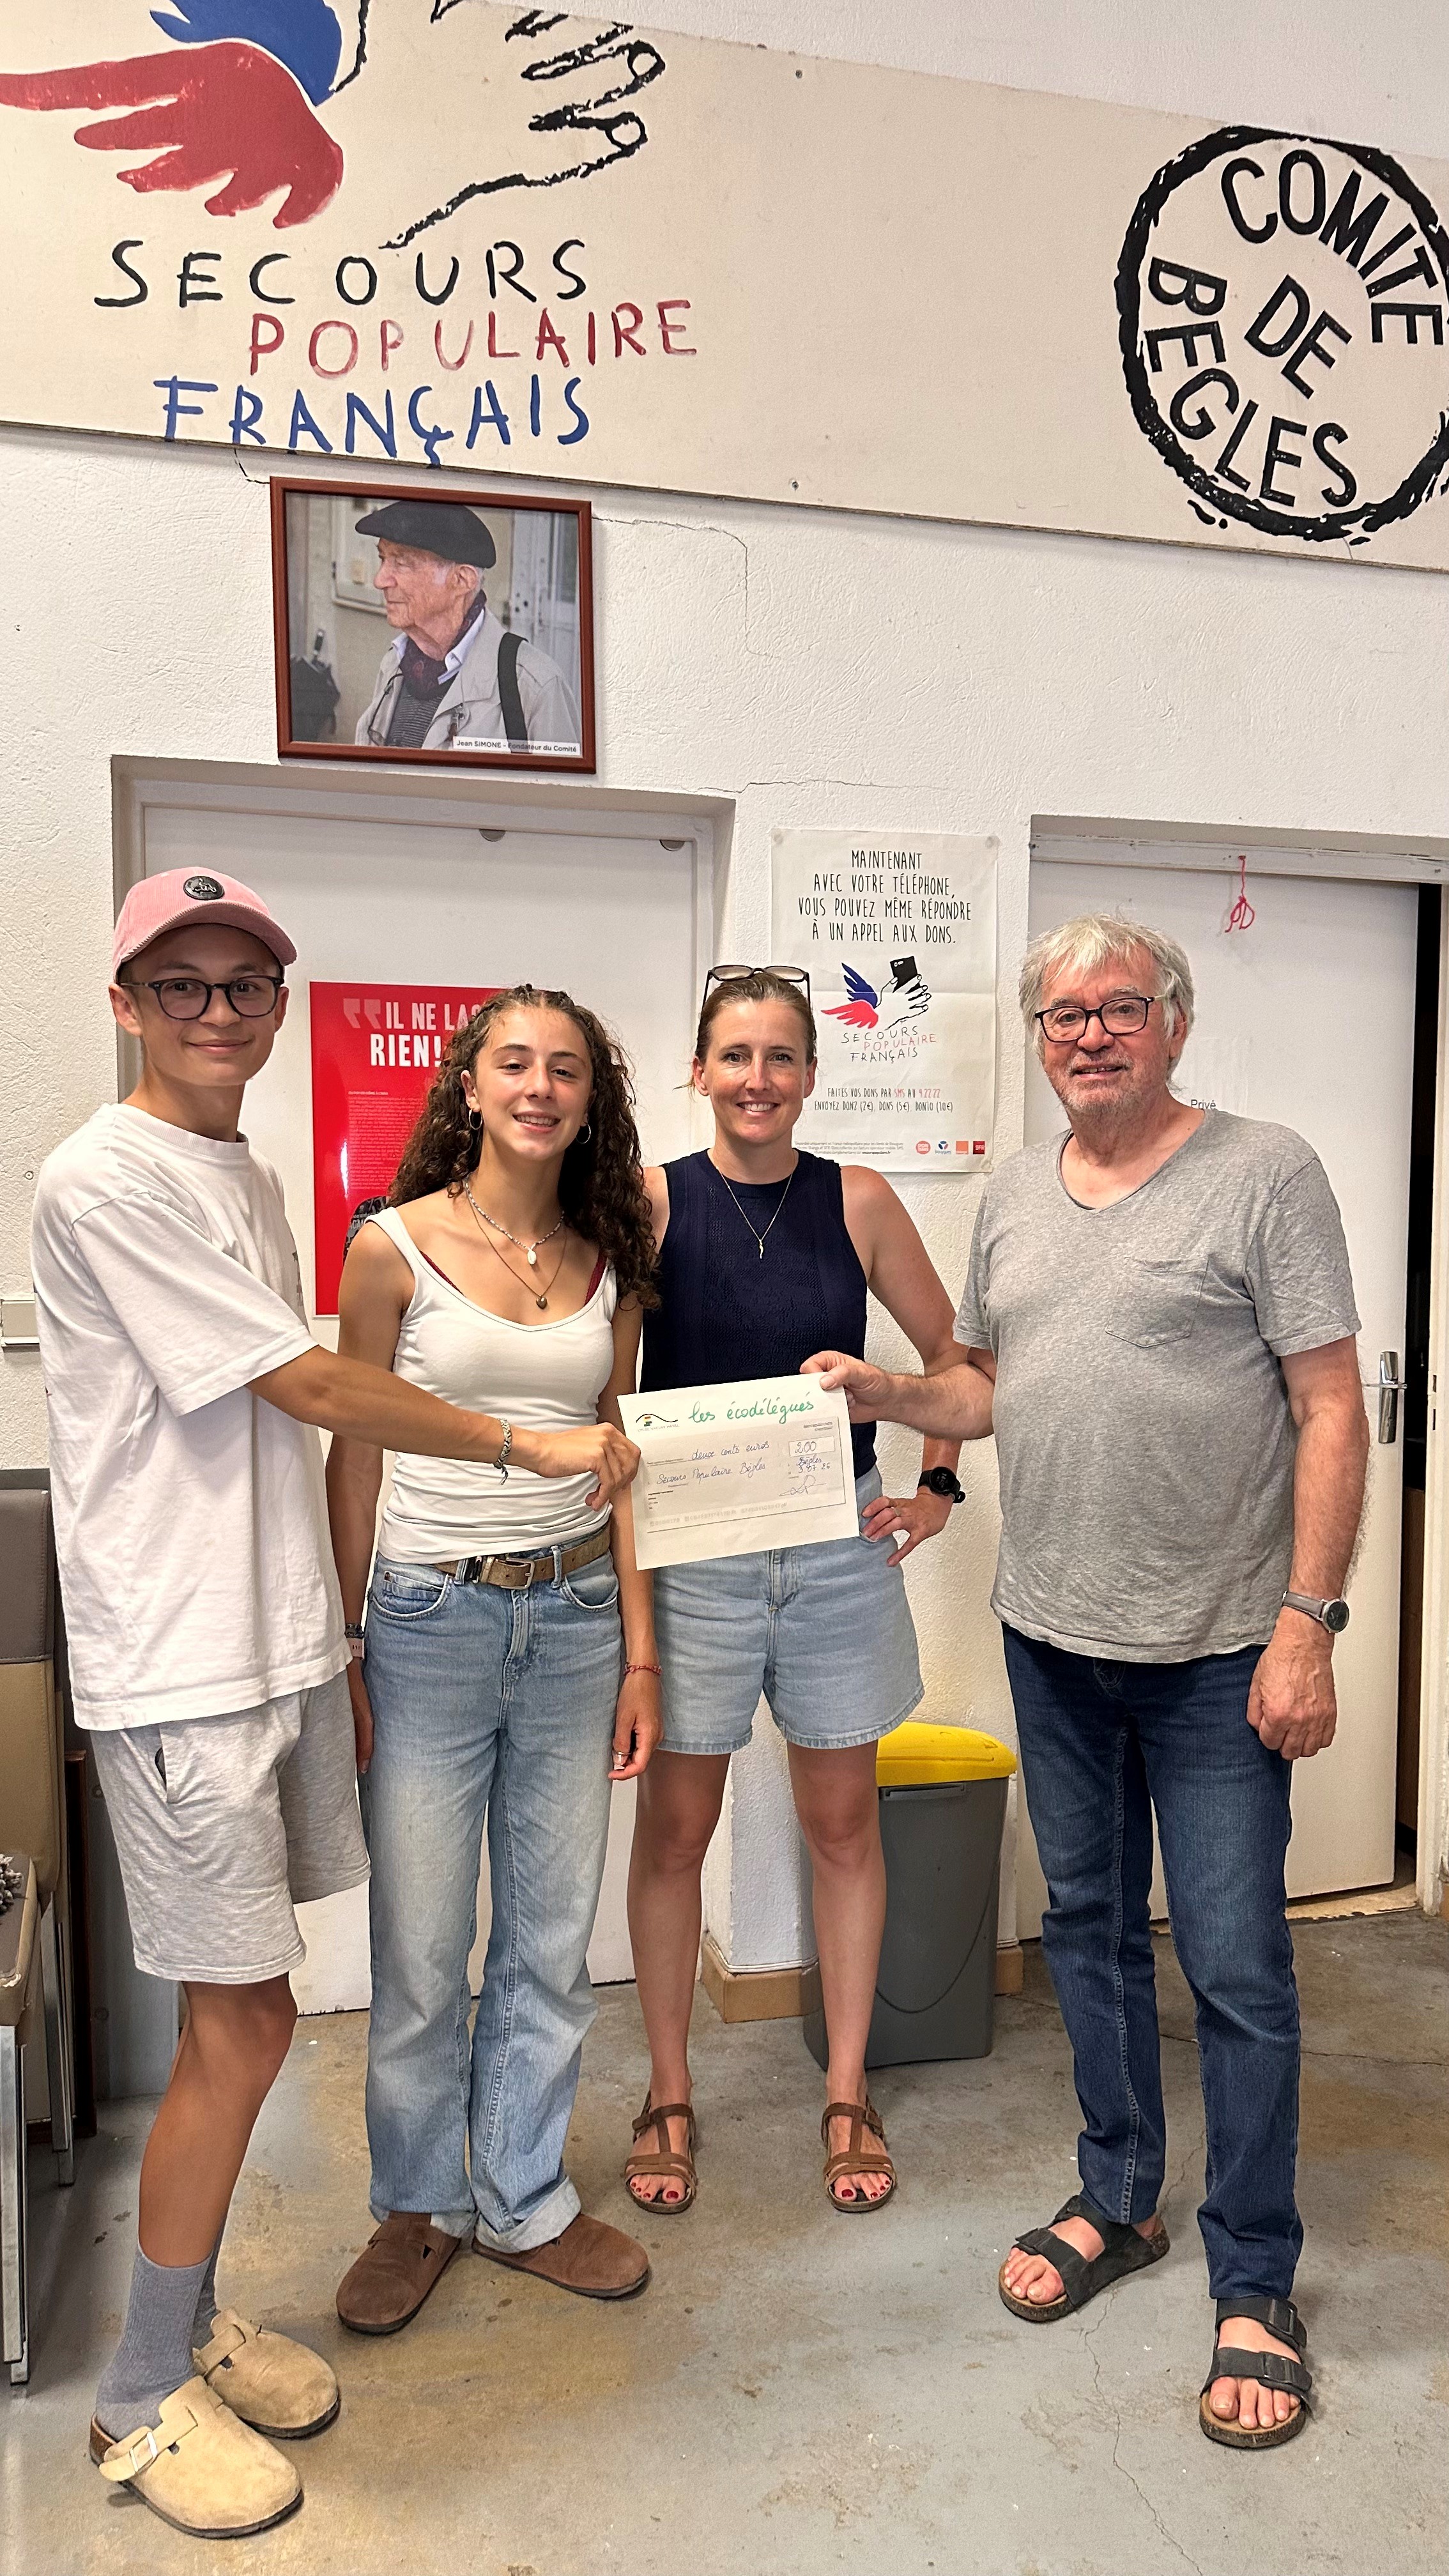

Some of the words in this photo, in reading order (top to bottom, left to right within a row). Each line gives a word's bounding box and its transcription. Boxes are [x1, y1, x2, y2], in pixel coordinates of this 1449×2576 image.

[1221, 150, 1444, 345] COMITE
[95, 240, 586, 307] SECOURS
[250, 300, 696, 379] POPULAIRE
[1243, 274, 1352, 399] DE
[1144, 257, 1356, 507] BEGLES
[154, 374, 590, 468] FRANÇAIS
[852, 850, 922, 870] MAINTENANT
[814, 873, 842, 892] AVEC
[852, 874, 884, 893] VOTRE
[893, 873, 955, 898] TÉLÉPHONE,
[799, 897, 826, 916] VOUS
[835, 898, 875, 917] POUVEZ
[885, 897, 912, 918] MÊME
[921, 898, 971, 921] RÉPONDRE
[813, 919, 819, 940] À
[829, 922, 843, 940] UN
[852, 923, 884, 942] APPEL
[893, 924, 917, 943] AUX
[926, 924, 956, 944] DONS.
[386, 1002, 404, 1029] IL
[412, 1002, 436, 1030] NE
[841, 1025, 918, 1043] SECOURS
[864, 1033, 936, 1052] POPULAIRE
[371, 1033, 441, 1068] RIEN!
[850, 1047, 918, 1064] FRANÇAIS
[815, 1100, 839, 1110] ENVOYEZ
[828, 1087, 848, 1097] FAITES
[851, 1088, 861, 1097] VOS
[864, 1088, 878, 1098] DONS
[881, 1088, 891, 1098] PAR
[894, 1088, 905, 1098] SMS
[908, 1089, 916, 1098] AU
[1191, 1100, 1216, 1109] Privé
[727, 1392, 814, 1424] écodélégués
[795, 1441, 816, 1453] 200
